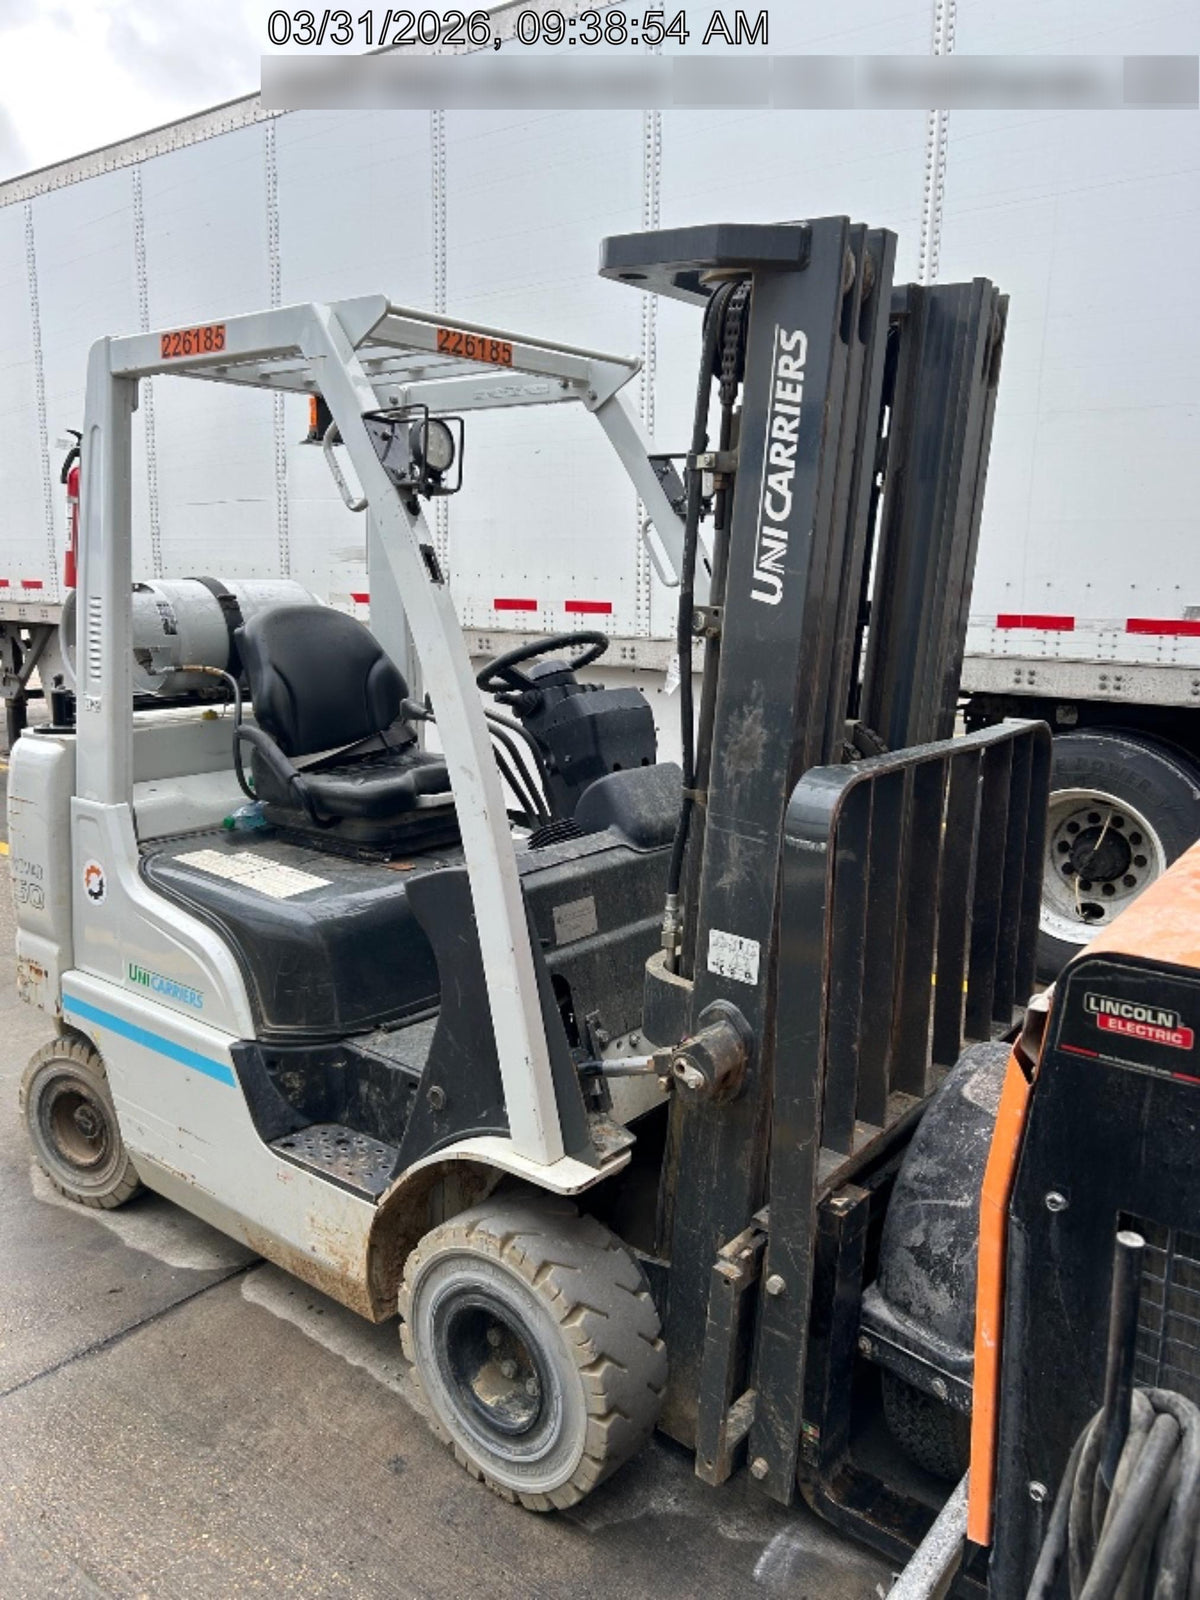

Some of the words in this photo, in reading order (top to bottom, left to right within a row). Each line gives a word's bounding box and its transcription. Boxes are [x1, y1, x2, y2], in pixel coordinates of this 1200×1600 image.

[161, 325, 225, 359] 226185
[438, 328, 512, 363] 226185
[750, 327, 808, 606] UNICARRIERS
[129, 963, 204, 1009] UNICARRIERS
[1089, 996, 1174, 1029] LINCOLN
[1108, 1017, 1183, 1045] ELECTRIC
